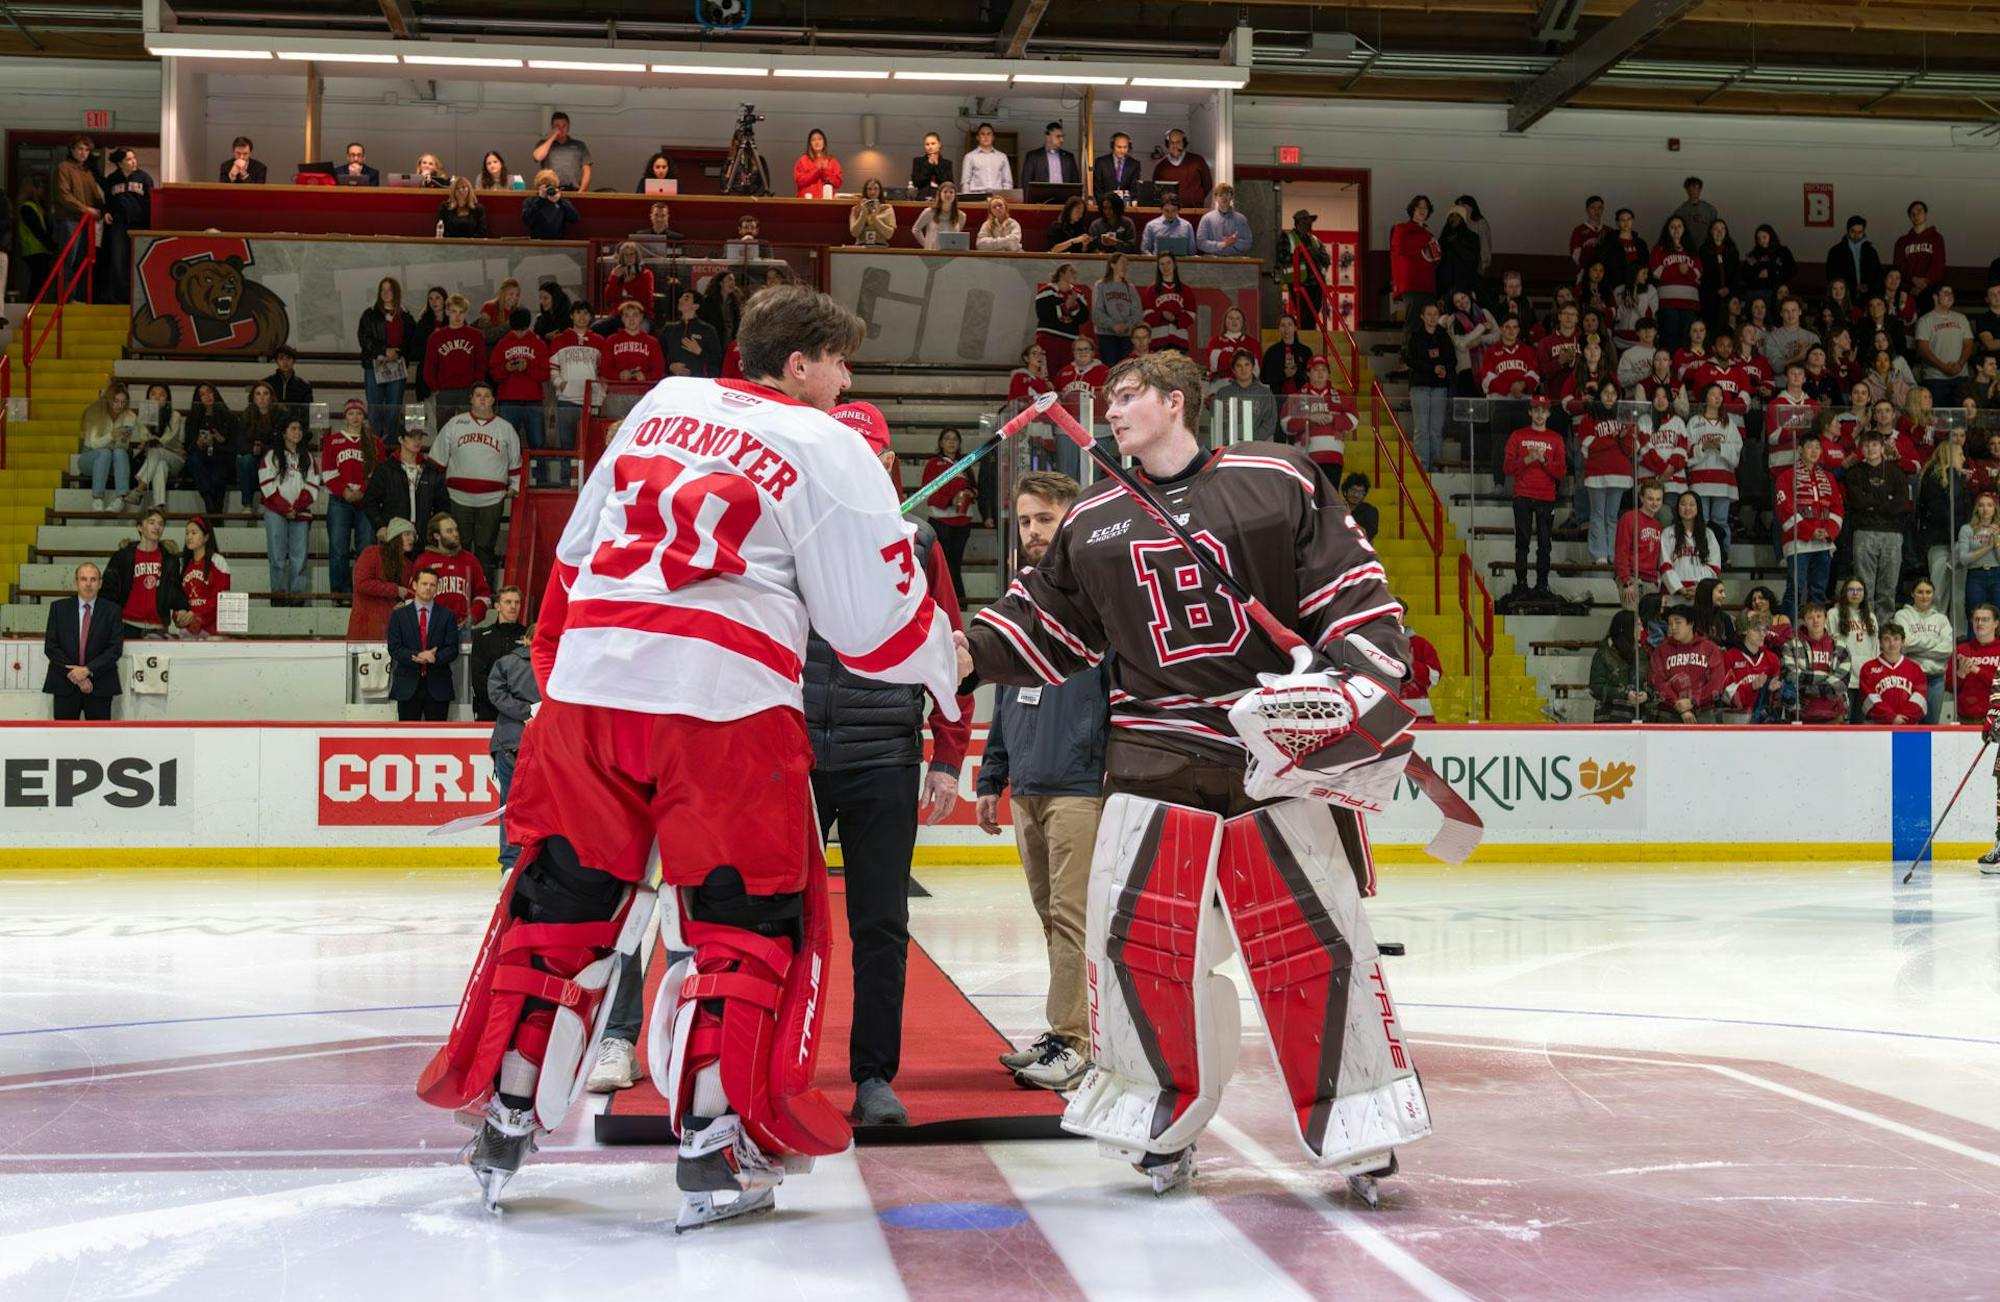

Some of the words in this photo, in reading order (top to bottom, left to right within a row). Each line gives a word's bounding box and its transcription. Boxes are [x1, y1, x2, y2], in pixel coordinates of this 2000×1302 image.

[86, 111, 107, 129] EXIT
[1279, 147, 1299, 164] EXIT
[1807, 192, 1831, 224] B
[1155, 293, 1184, 308] CORNELL
[438, 339, 475, 356] CORNELL
[505, 345, 536, 360] CORNELL
[613, 341, 650, 355] CORNELL
[722, 391, 763, 405] CCM
[831, 410, 873, 425] CORNELL
[457, 433, 501, 452] CORNELL
[591, 454, 762, 592] 30
[1091, 518, 1132, 539] ECAC
[1130, 529, 1250, 667] B
[147, 657, 157, 669] G
[359, 663, 369, 676] G
[1366, 649, 1405, 674] TRUE
[1666, 652, 1708, 671] CORNELL
[135, 671, 145, 682] G
[1875, 675, 1913, 694] CORNELL
[4, 757, 177, 808] EPSI
[1309, 787, 1383, 814] TRUE
[799, 951, 822, 1065] TRUE
[1088, 959, 1102, 1058] TRUE
[1368, 962, 1407, 1070] TRUE
